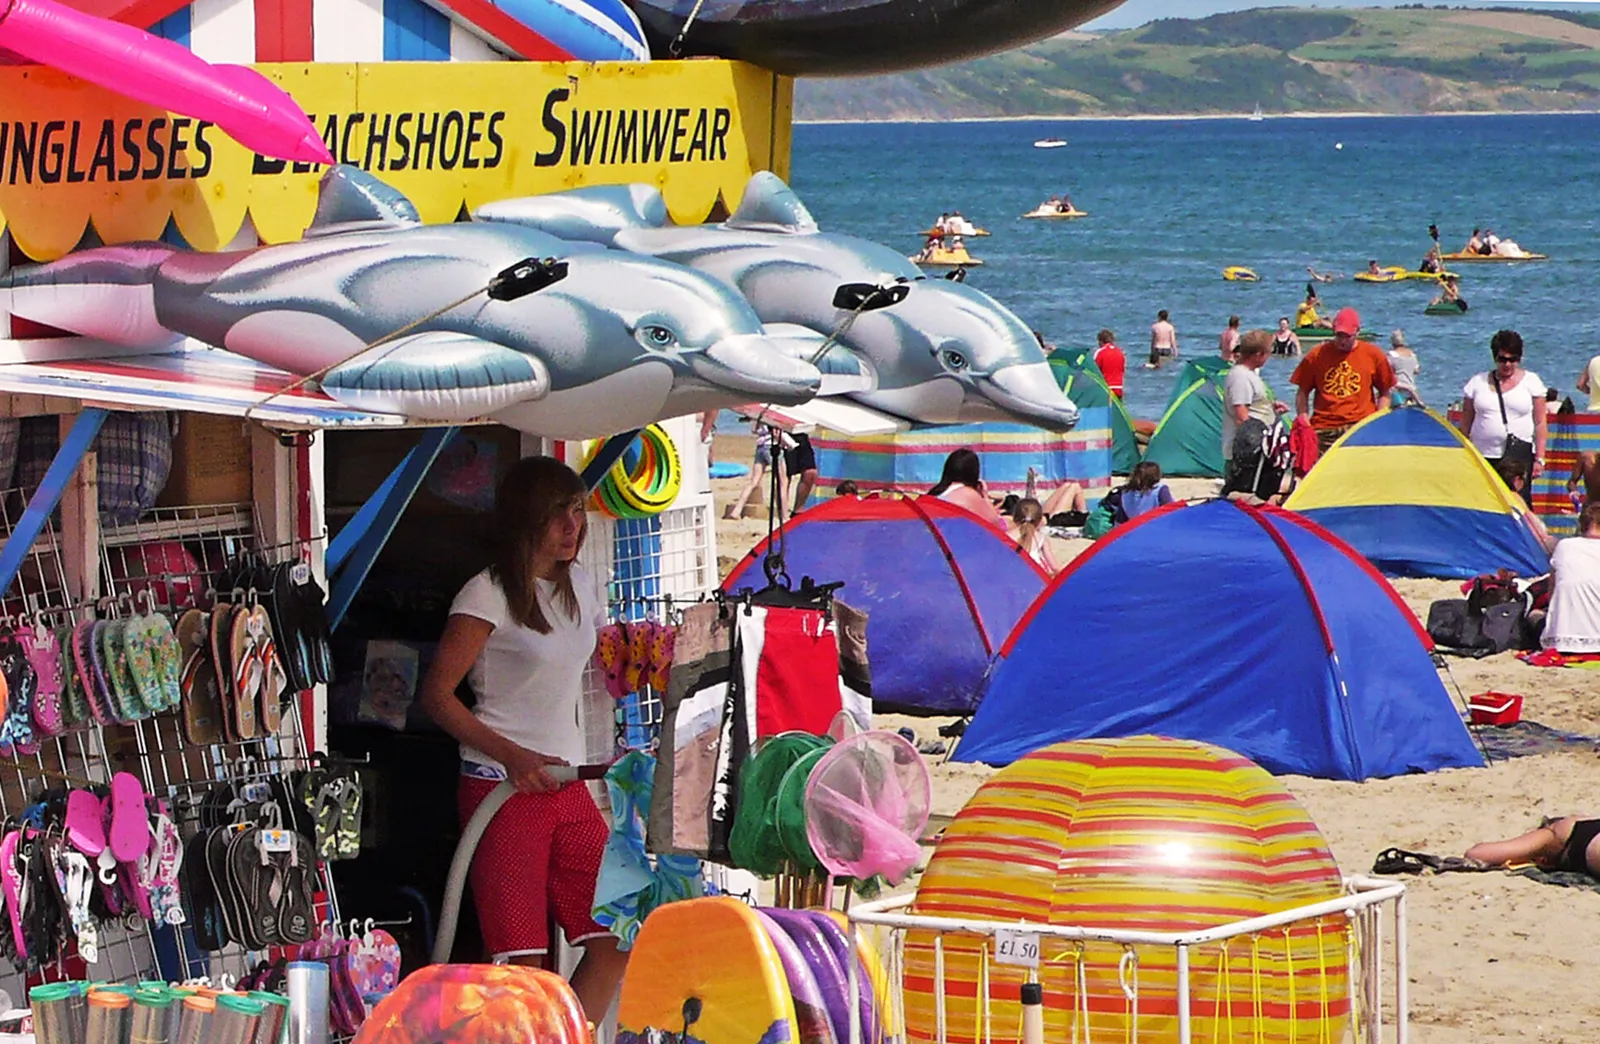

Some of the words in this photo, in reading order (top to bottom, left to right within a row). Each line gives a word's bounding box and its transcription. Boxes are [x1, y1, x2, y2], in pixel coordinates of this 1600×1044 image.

[252, 111, 505, 174] ACHSHOES
[534, 88, 731, 167] SWIMWEAR
[1000, 940, 1038, 959] £1.50
